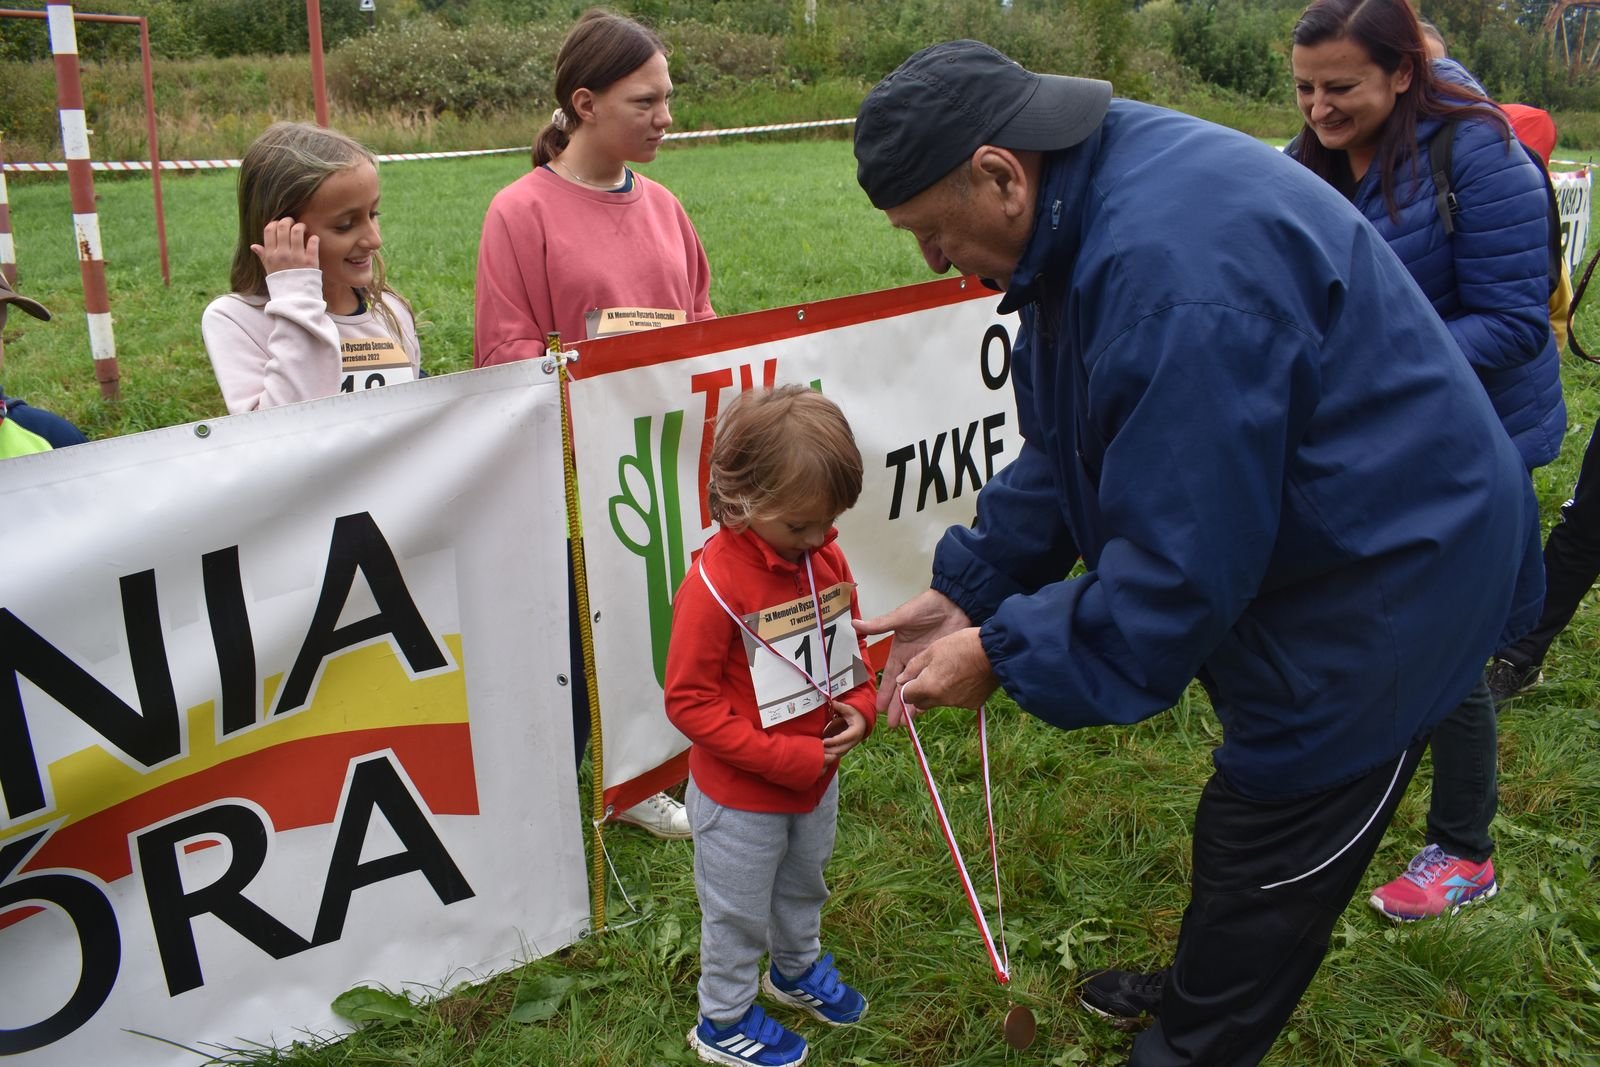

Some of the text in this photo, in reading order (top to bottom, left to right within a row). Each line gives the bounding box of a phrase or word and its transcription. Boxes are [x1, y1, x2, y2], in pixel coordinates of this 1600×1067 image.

[345, 342, 371, 352] Ryszarda
[367, 353, 380, 361] 2022
[886, 412, 1006, 521] TKKF
[798, 597, 823, 613] Ryszaa
[0, 511, 449, 820] NIA
[795, 624, 837, 684] 17
